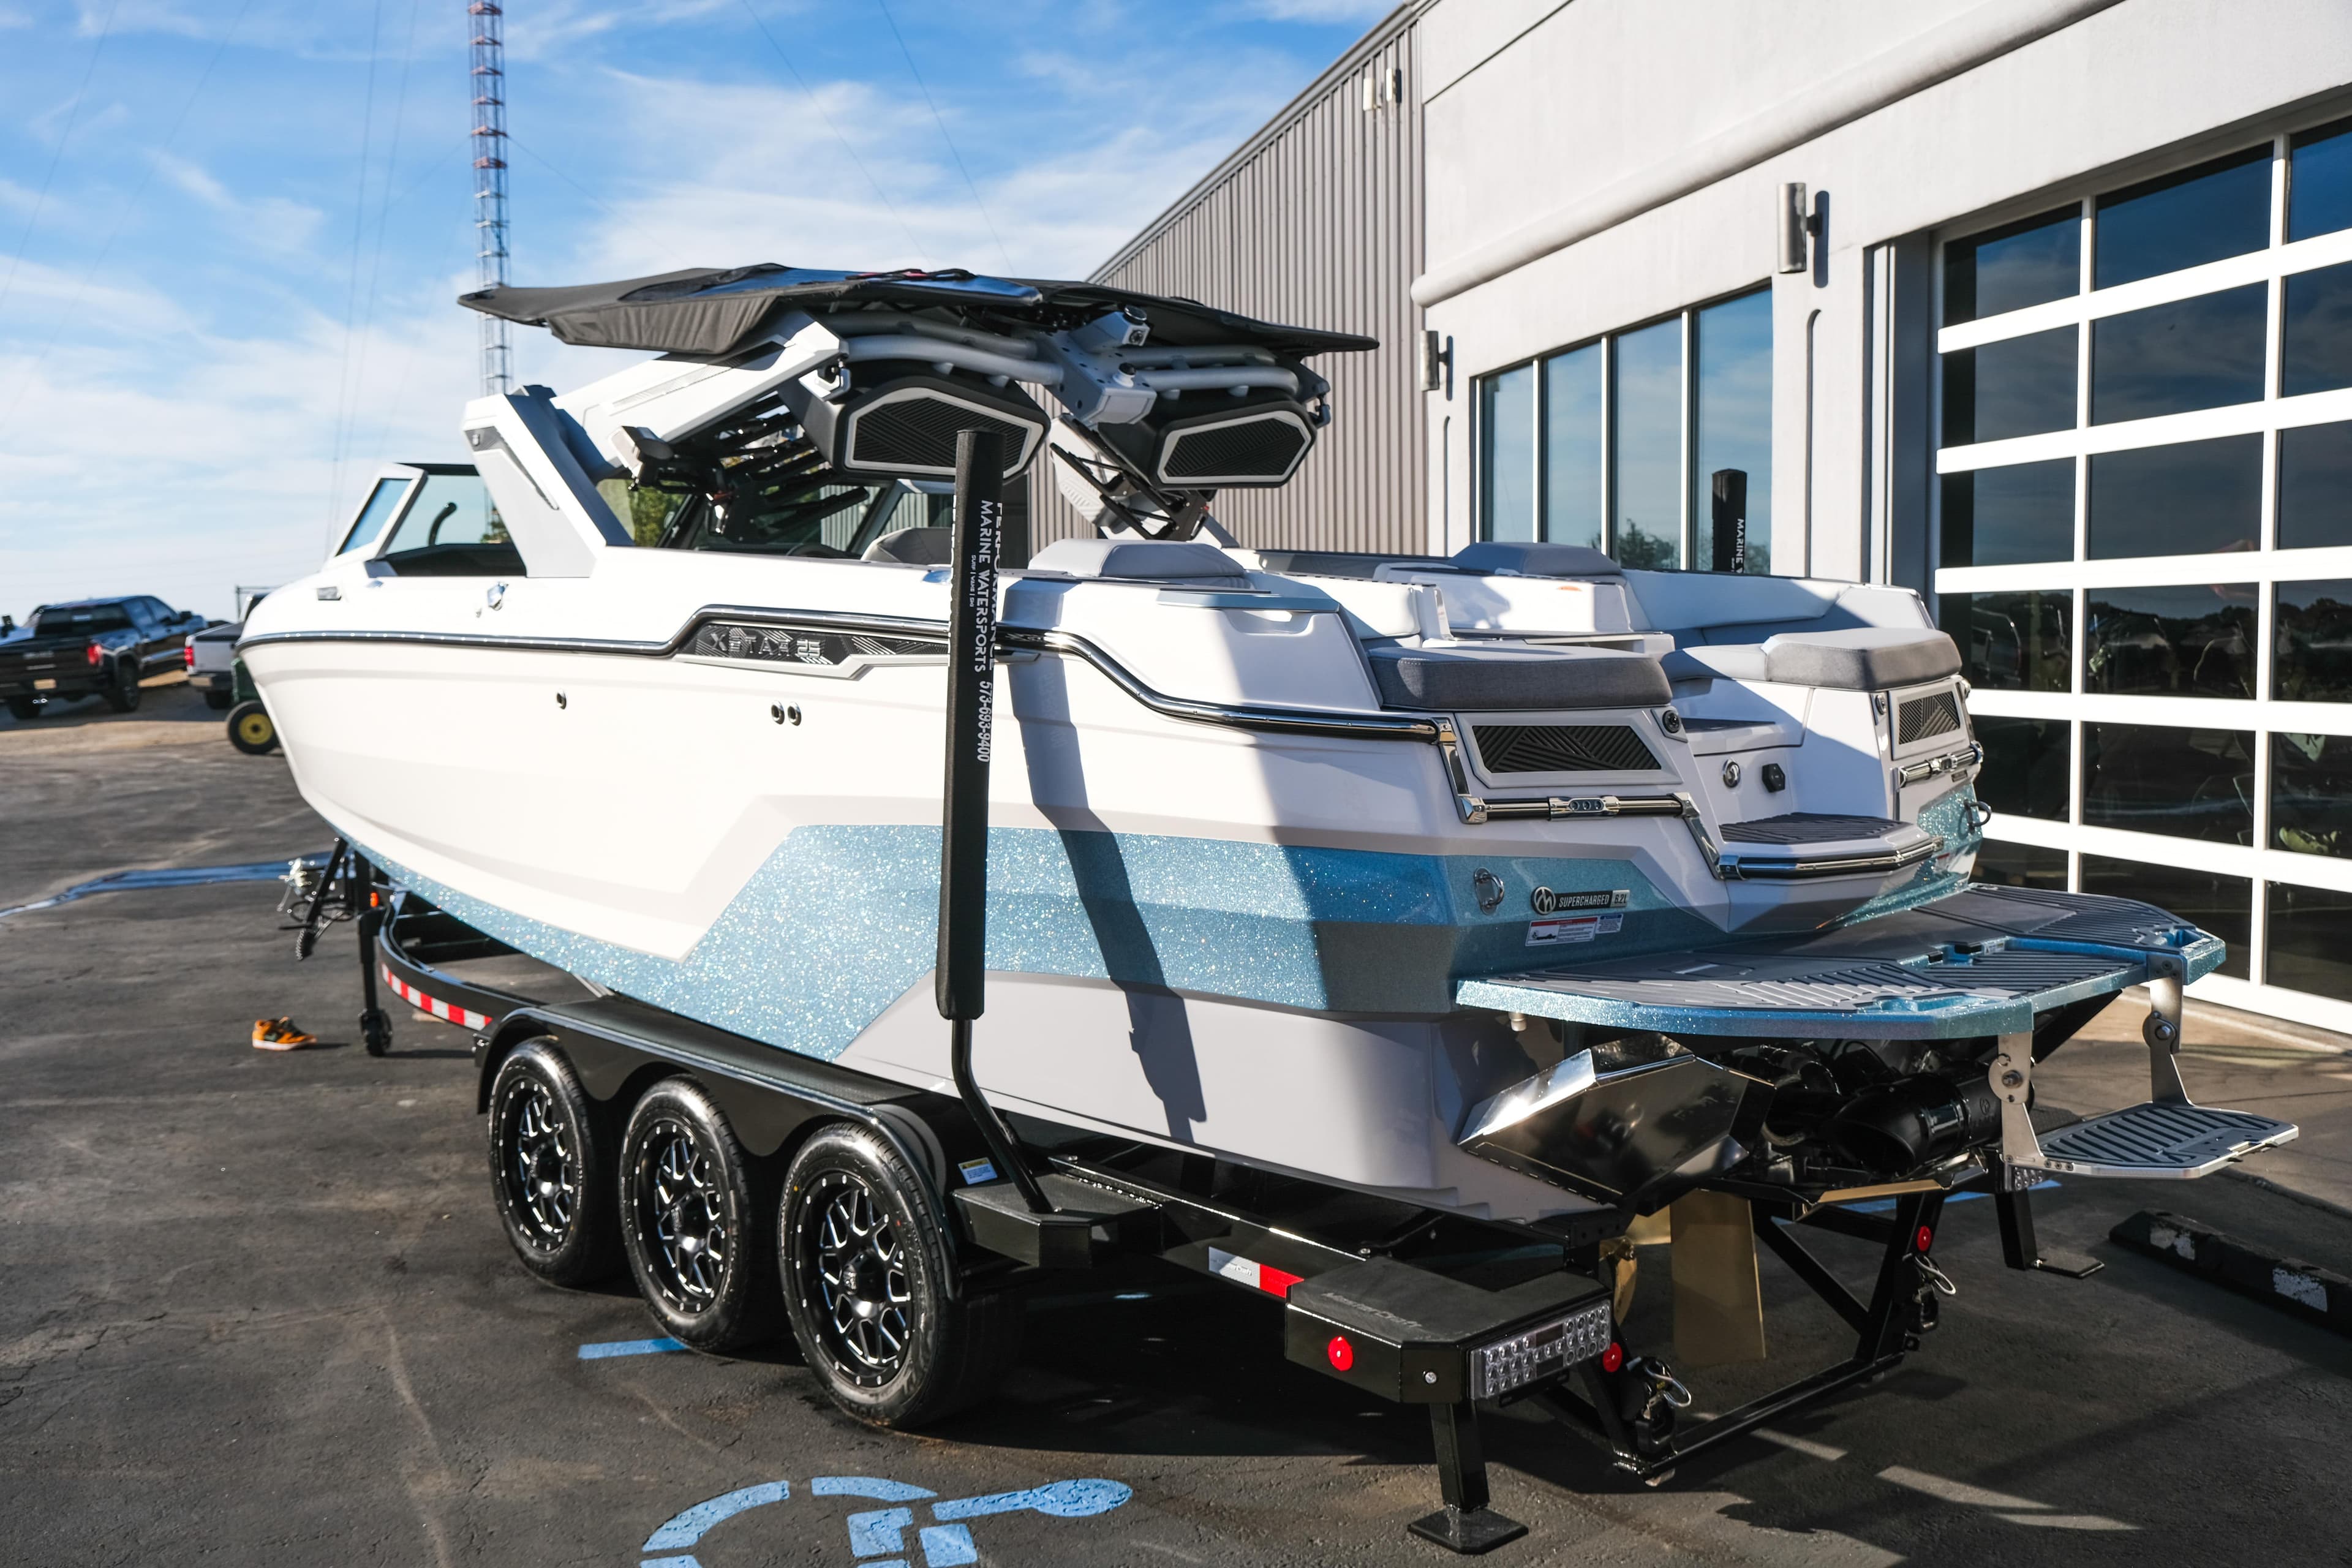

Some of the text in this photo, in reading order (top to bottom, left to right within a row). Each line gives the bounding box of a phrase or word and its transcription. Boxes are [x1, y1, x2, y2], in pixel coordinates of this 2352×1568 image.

[1735, 518, 1745, 564] MARINE
[974, 499, 993, 673] MARINE WATERSPORTS
[796, 639, 821, 657] 25
[977, 680, 993, 763] 573-693-9400
[1558, 894, 1610, 908] SUPERCHARGED
